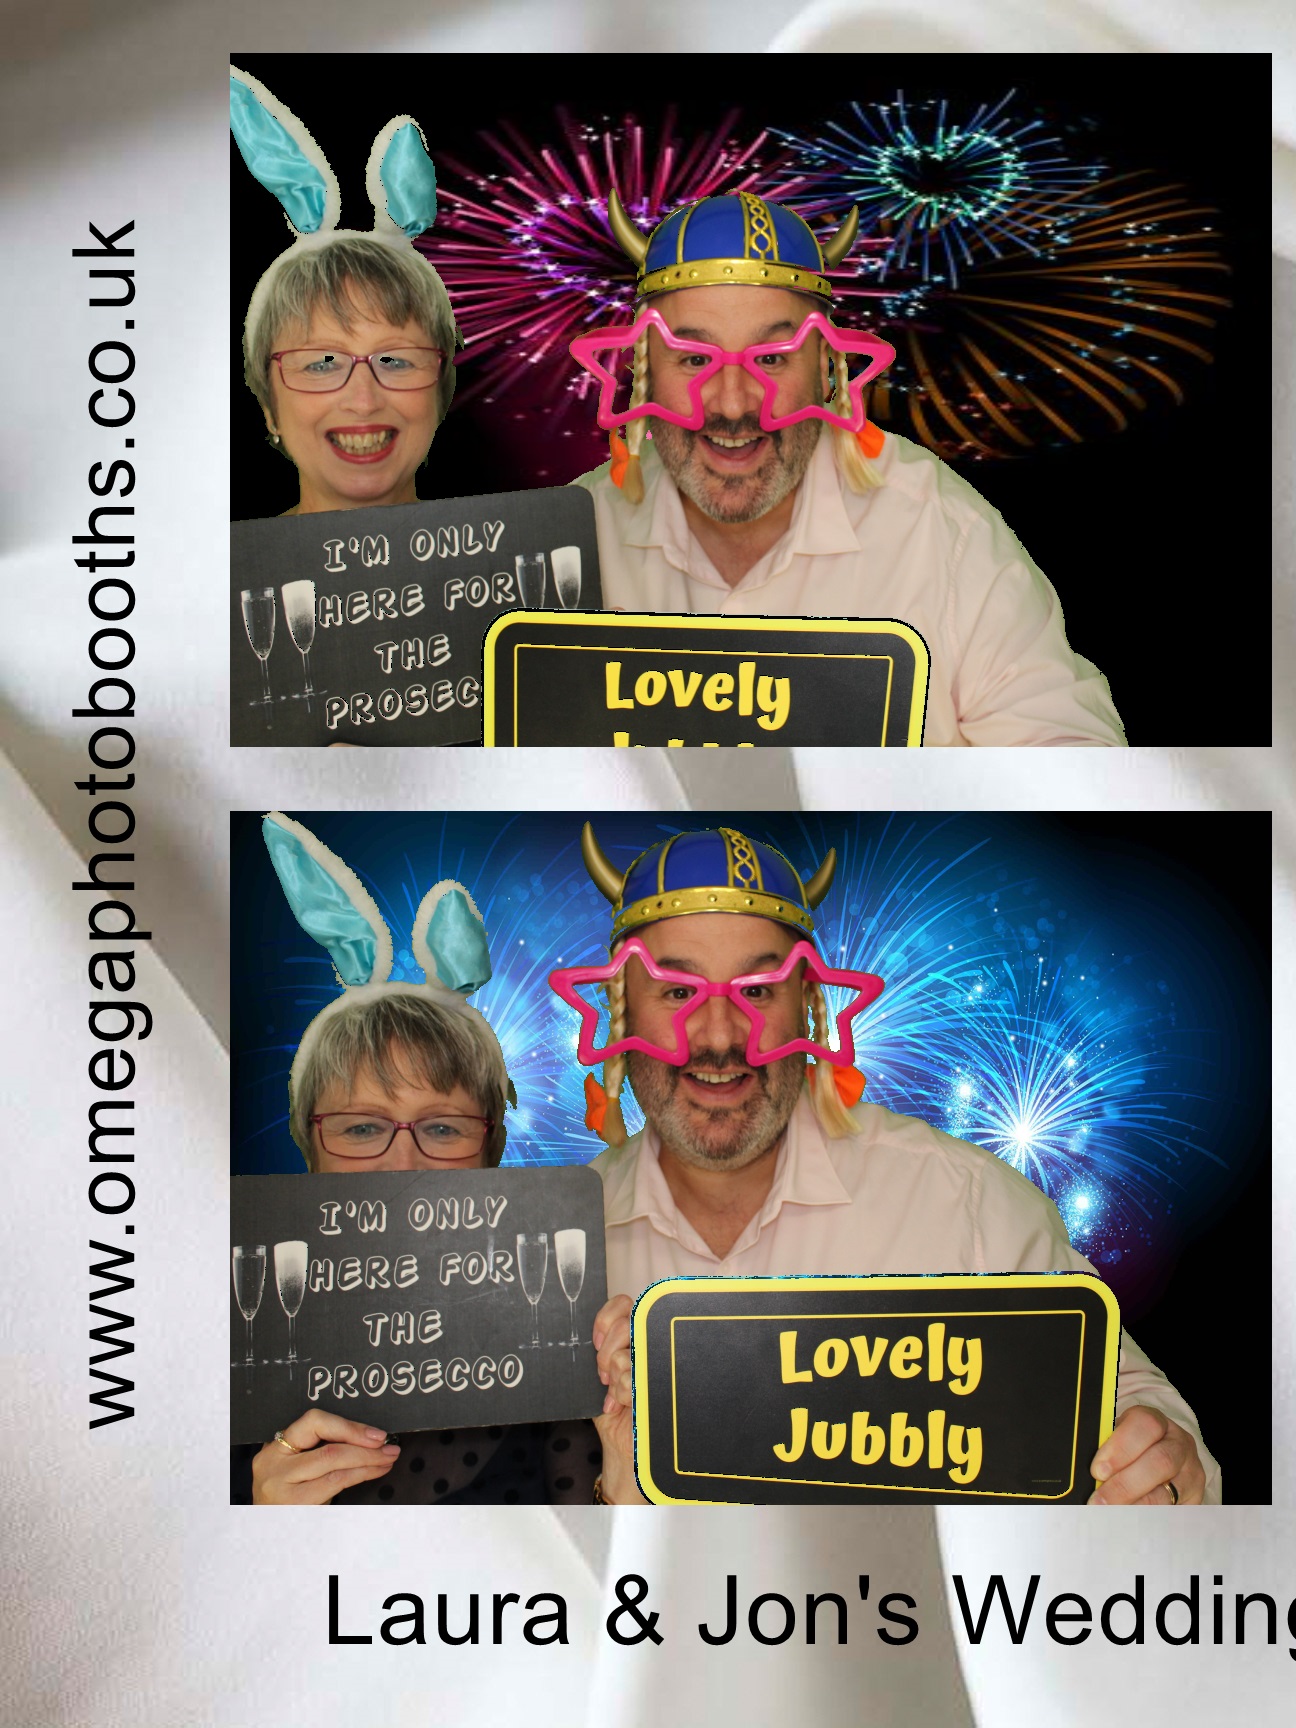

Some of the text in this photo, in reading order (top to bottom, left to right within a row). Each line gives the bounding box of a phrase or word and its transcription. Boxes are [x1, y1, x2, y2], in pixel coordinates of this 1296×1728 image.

[323, 520, 505, 572] I'M ONLY
[318, 572, 516, 628] HERE FOR
[374, 633, 452, 674] THE
[325, 676, 480, 730] PROSEC
[605, 661, 791, 731] Lovely
[319, 1195, 508, 1235] I'M ONLY
[309, 1250, 515, 1292] HERE FOR
[362, 1309, 444, 1347] THE
[307, 1353, 524, 1401] PROSECCO
[779, 1322, 983, 1396] Lovely
[772, 1407, 983, 1485] Jubbly
